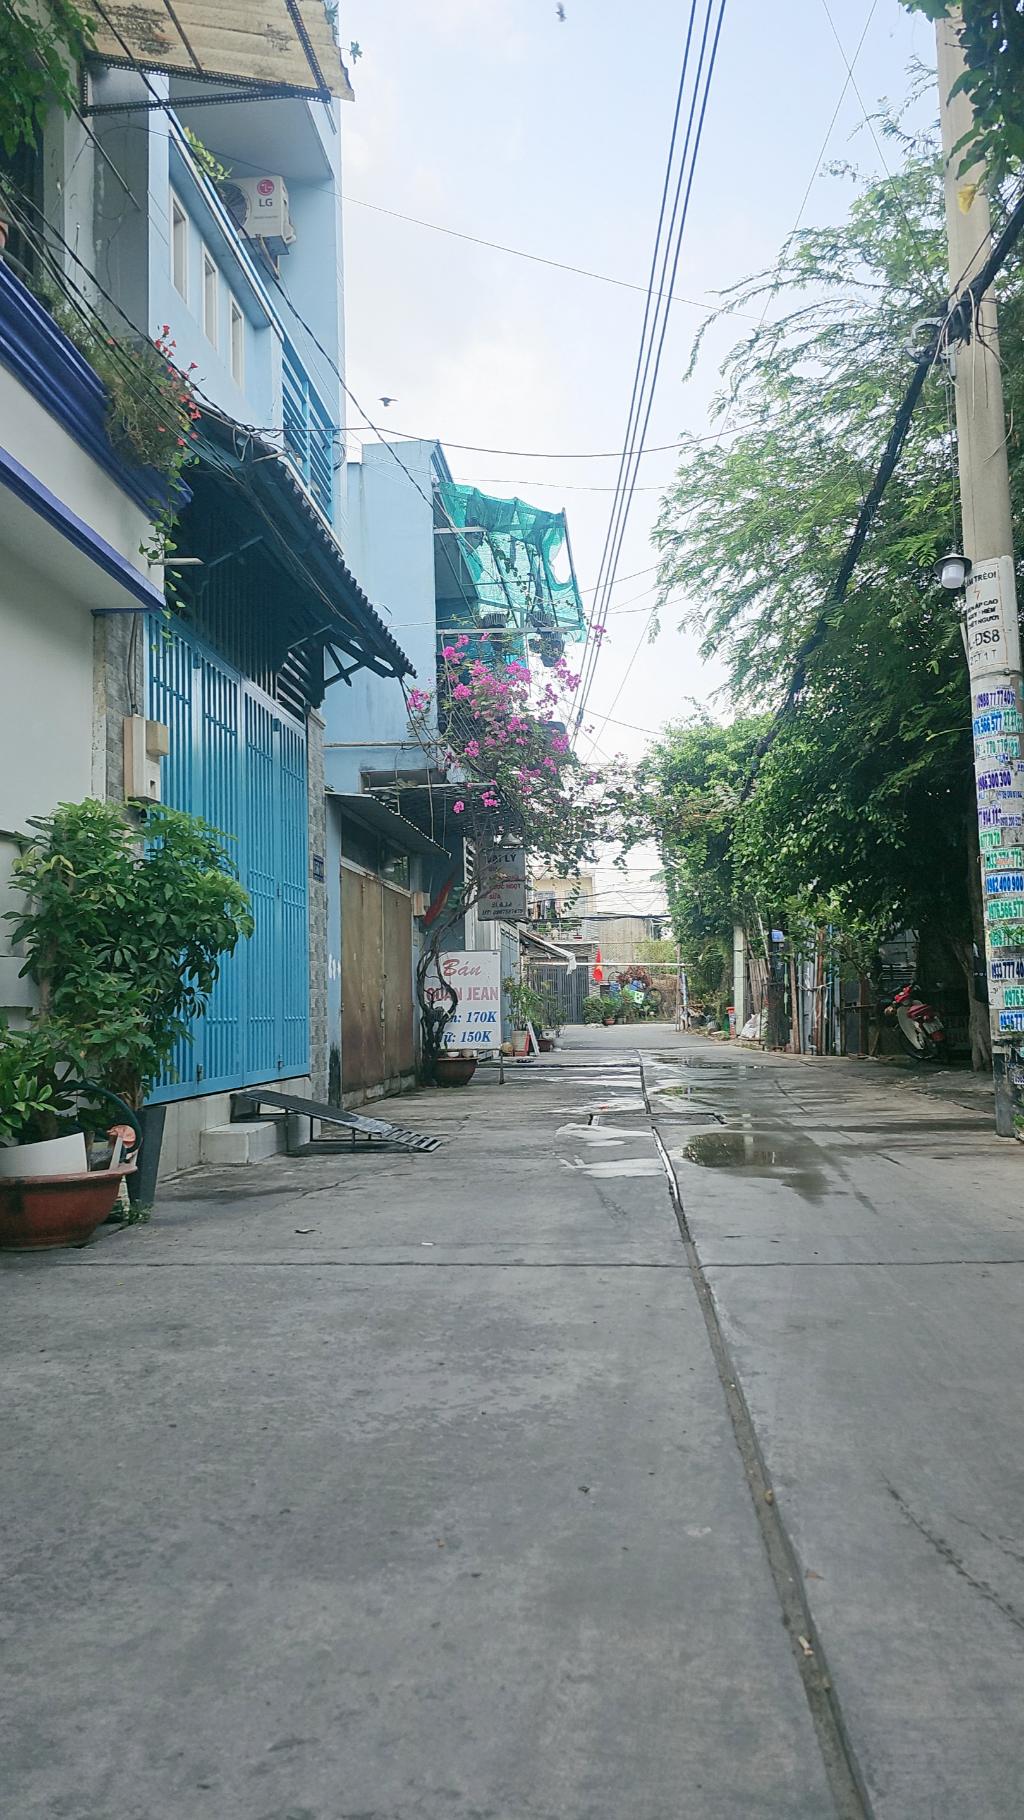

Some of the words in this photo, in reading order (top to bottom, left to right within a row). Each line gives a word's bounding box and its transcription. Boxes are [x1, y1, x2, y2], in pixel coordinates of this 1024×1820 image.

[259, 198, 273, 207] LG
[443, 959, 482, 977] Bán
[466, 986, 499, 1001] JEAN
[466, 1011, 497, 1023] 170K
[460, 1031, 492, 1043] 150K
